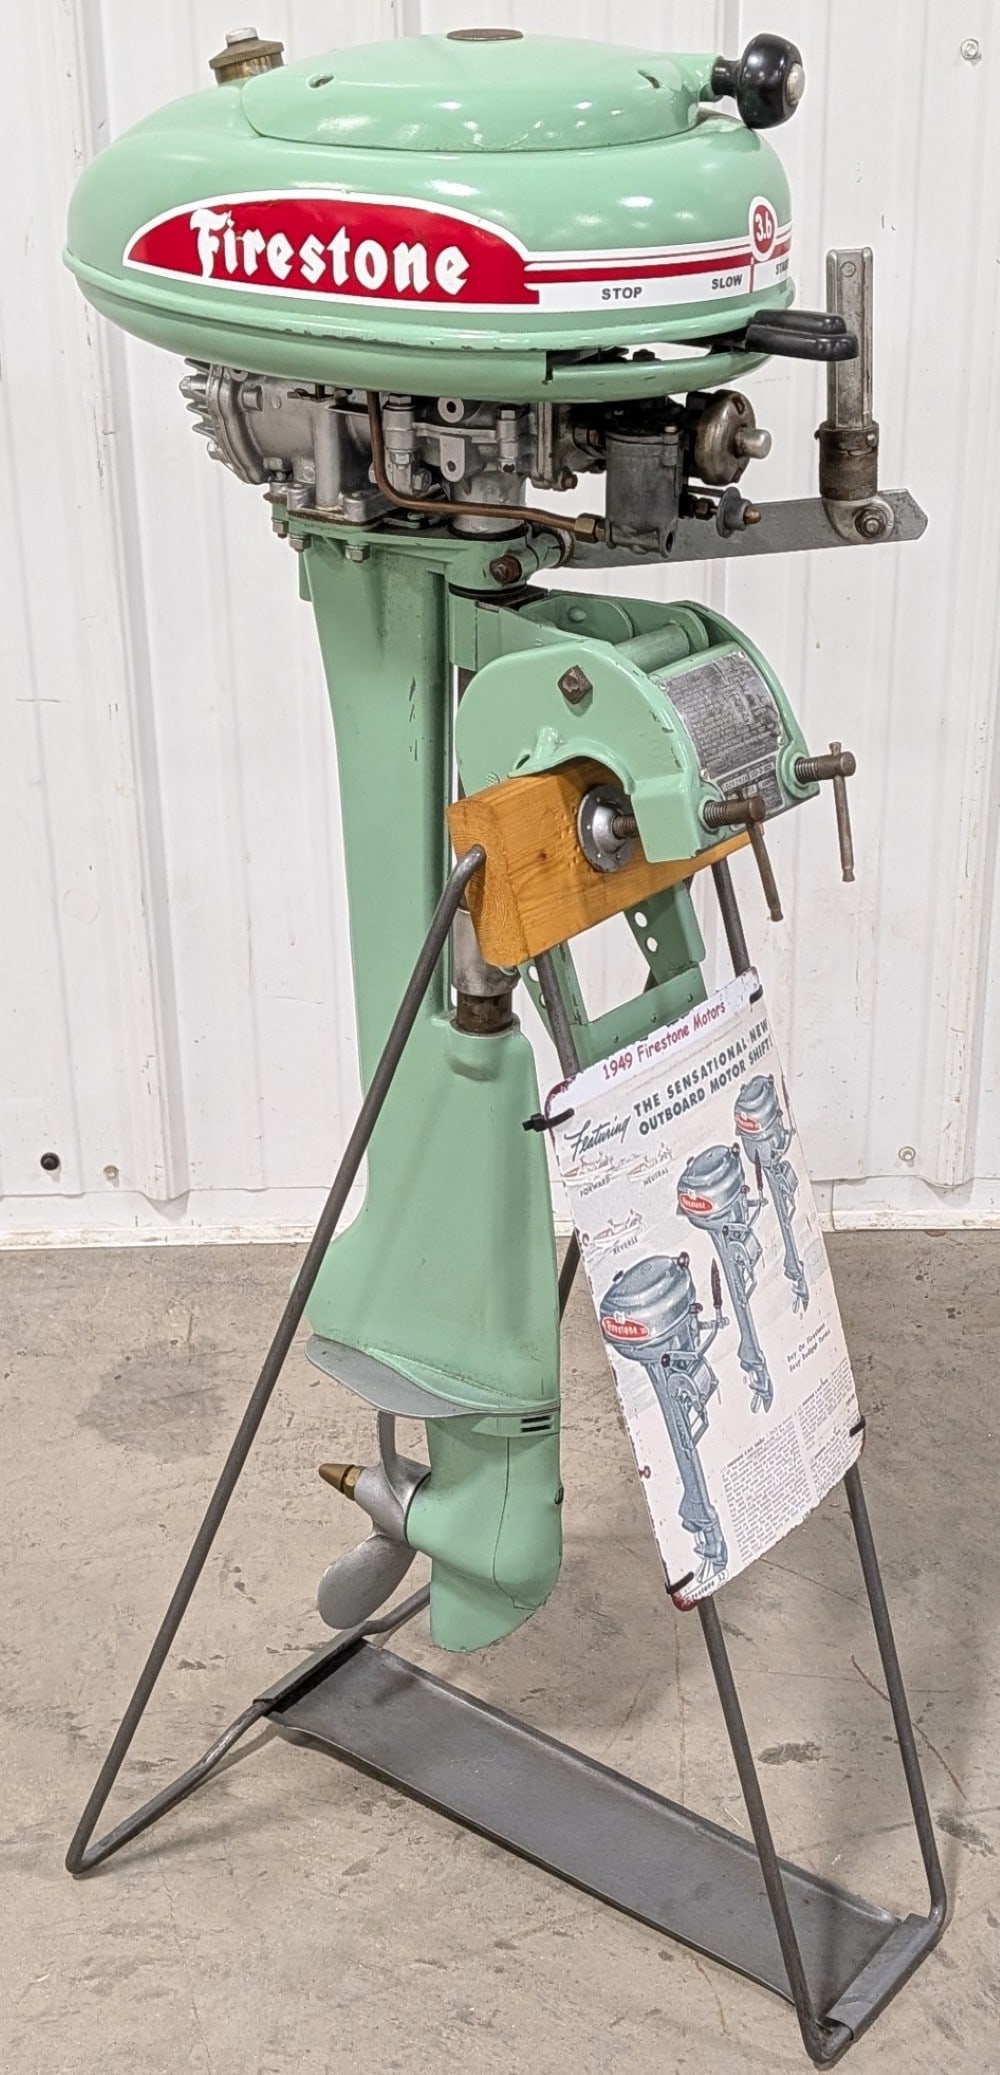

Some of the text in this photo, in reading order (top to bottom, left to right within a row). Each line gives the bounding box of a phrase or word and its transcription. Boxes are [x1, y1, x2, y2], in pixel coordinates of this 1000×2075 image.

[189, 207, 470, 296] Firestone
[602, 286, 642, 300] STOP
[711, 274, 742, 290] SLOW
[602, 1000, 726, 1080] 1949 Firestone Motors
[634, 1019, 769, 1118] THE SENSATIONAL NEW
[639, 1088, 706, 1136] OUTBOARD
[711, 1060, 747, 1092] MOTOR
[749, 1035, 774, 1066] SHIFT!
[564, 1115, 632, 1161] Featuring
[579, 1175, 611, 1197] FORWARD
[643, 1168, 669, 1186] NEUTRAL
[612, 1237, 639, 1256] REVERSE
